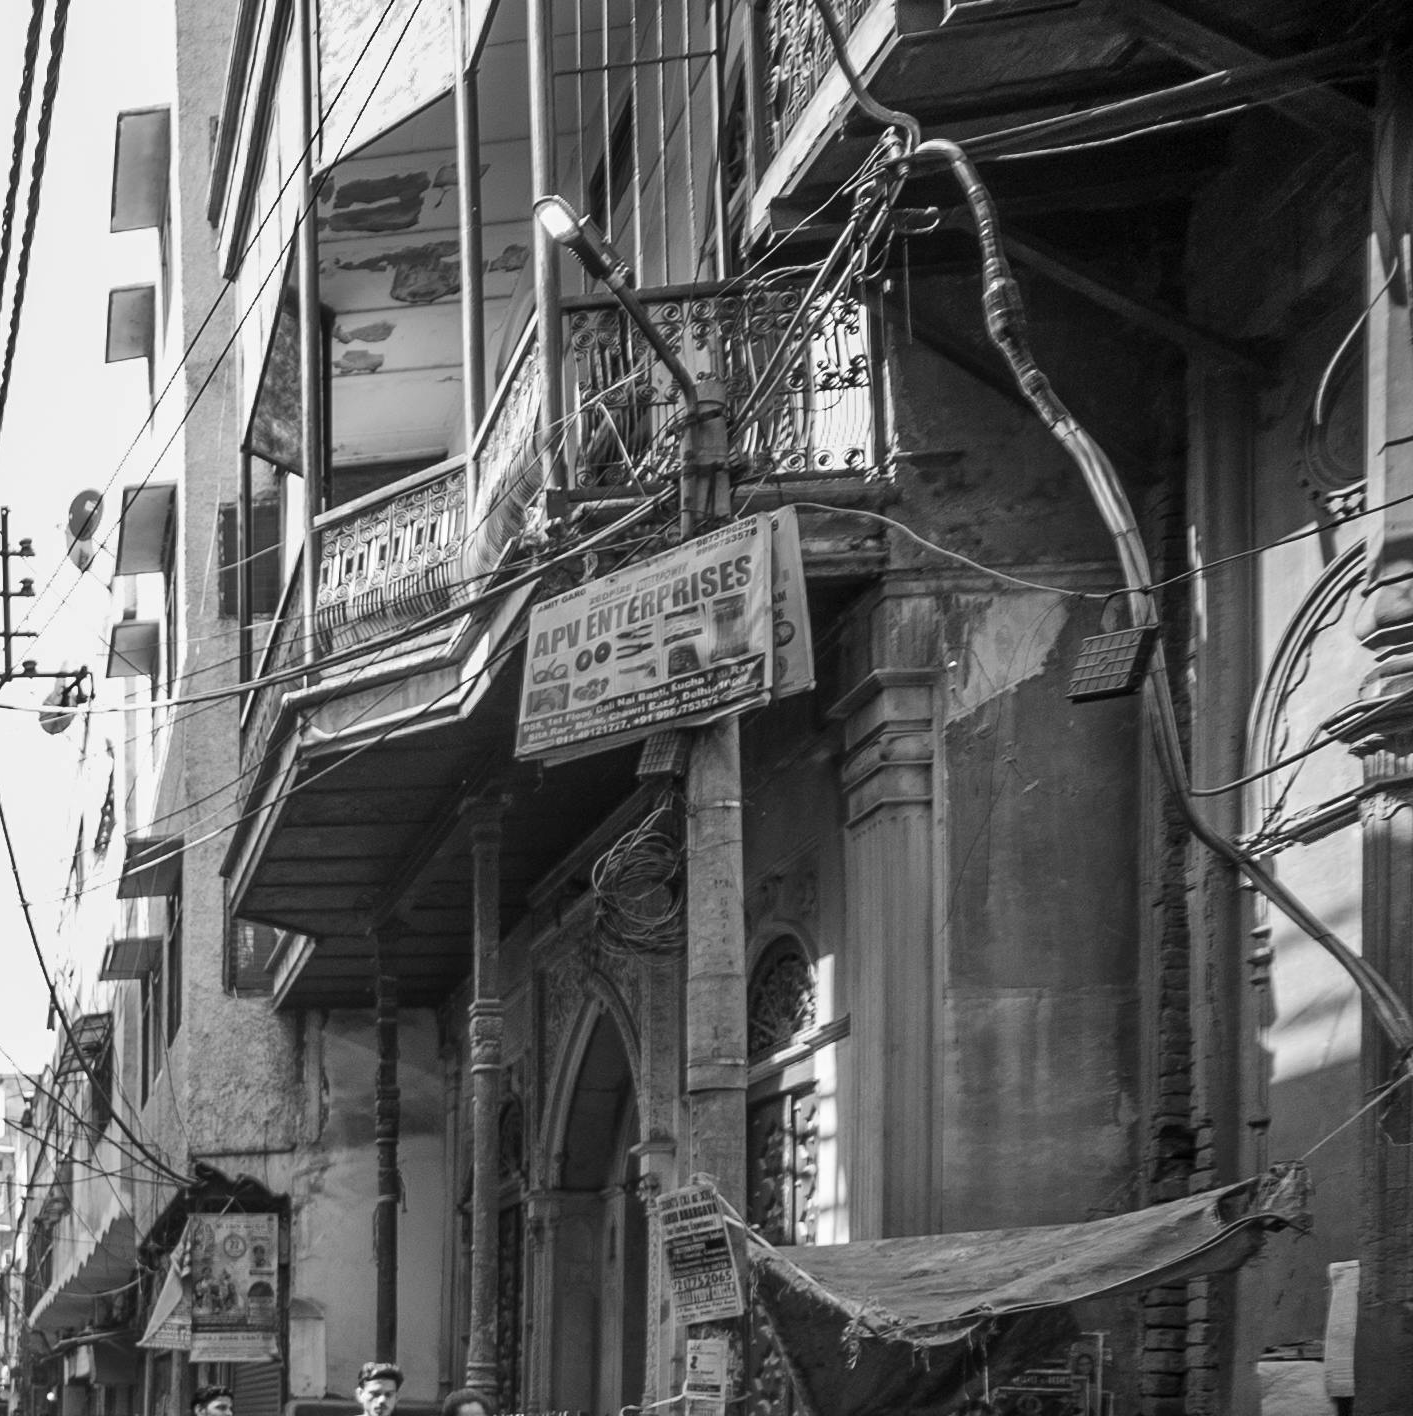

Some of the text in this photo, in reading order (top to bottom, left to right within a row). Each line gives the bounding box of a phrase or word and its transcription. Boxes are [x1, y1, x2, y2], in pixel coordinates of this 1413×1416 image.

[533, 618, 581, 659] APV
[586, 554, 753, 641] ENTERPRISES
[595, 699, 616, 715] Gali
[617, 694, 636, 708] Nai
[609, 704, 647, 724] Chawri
[633, 713, 654, 727] +91
